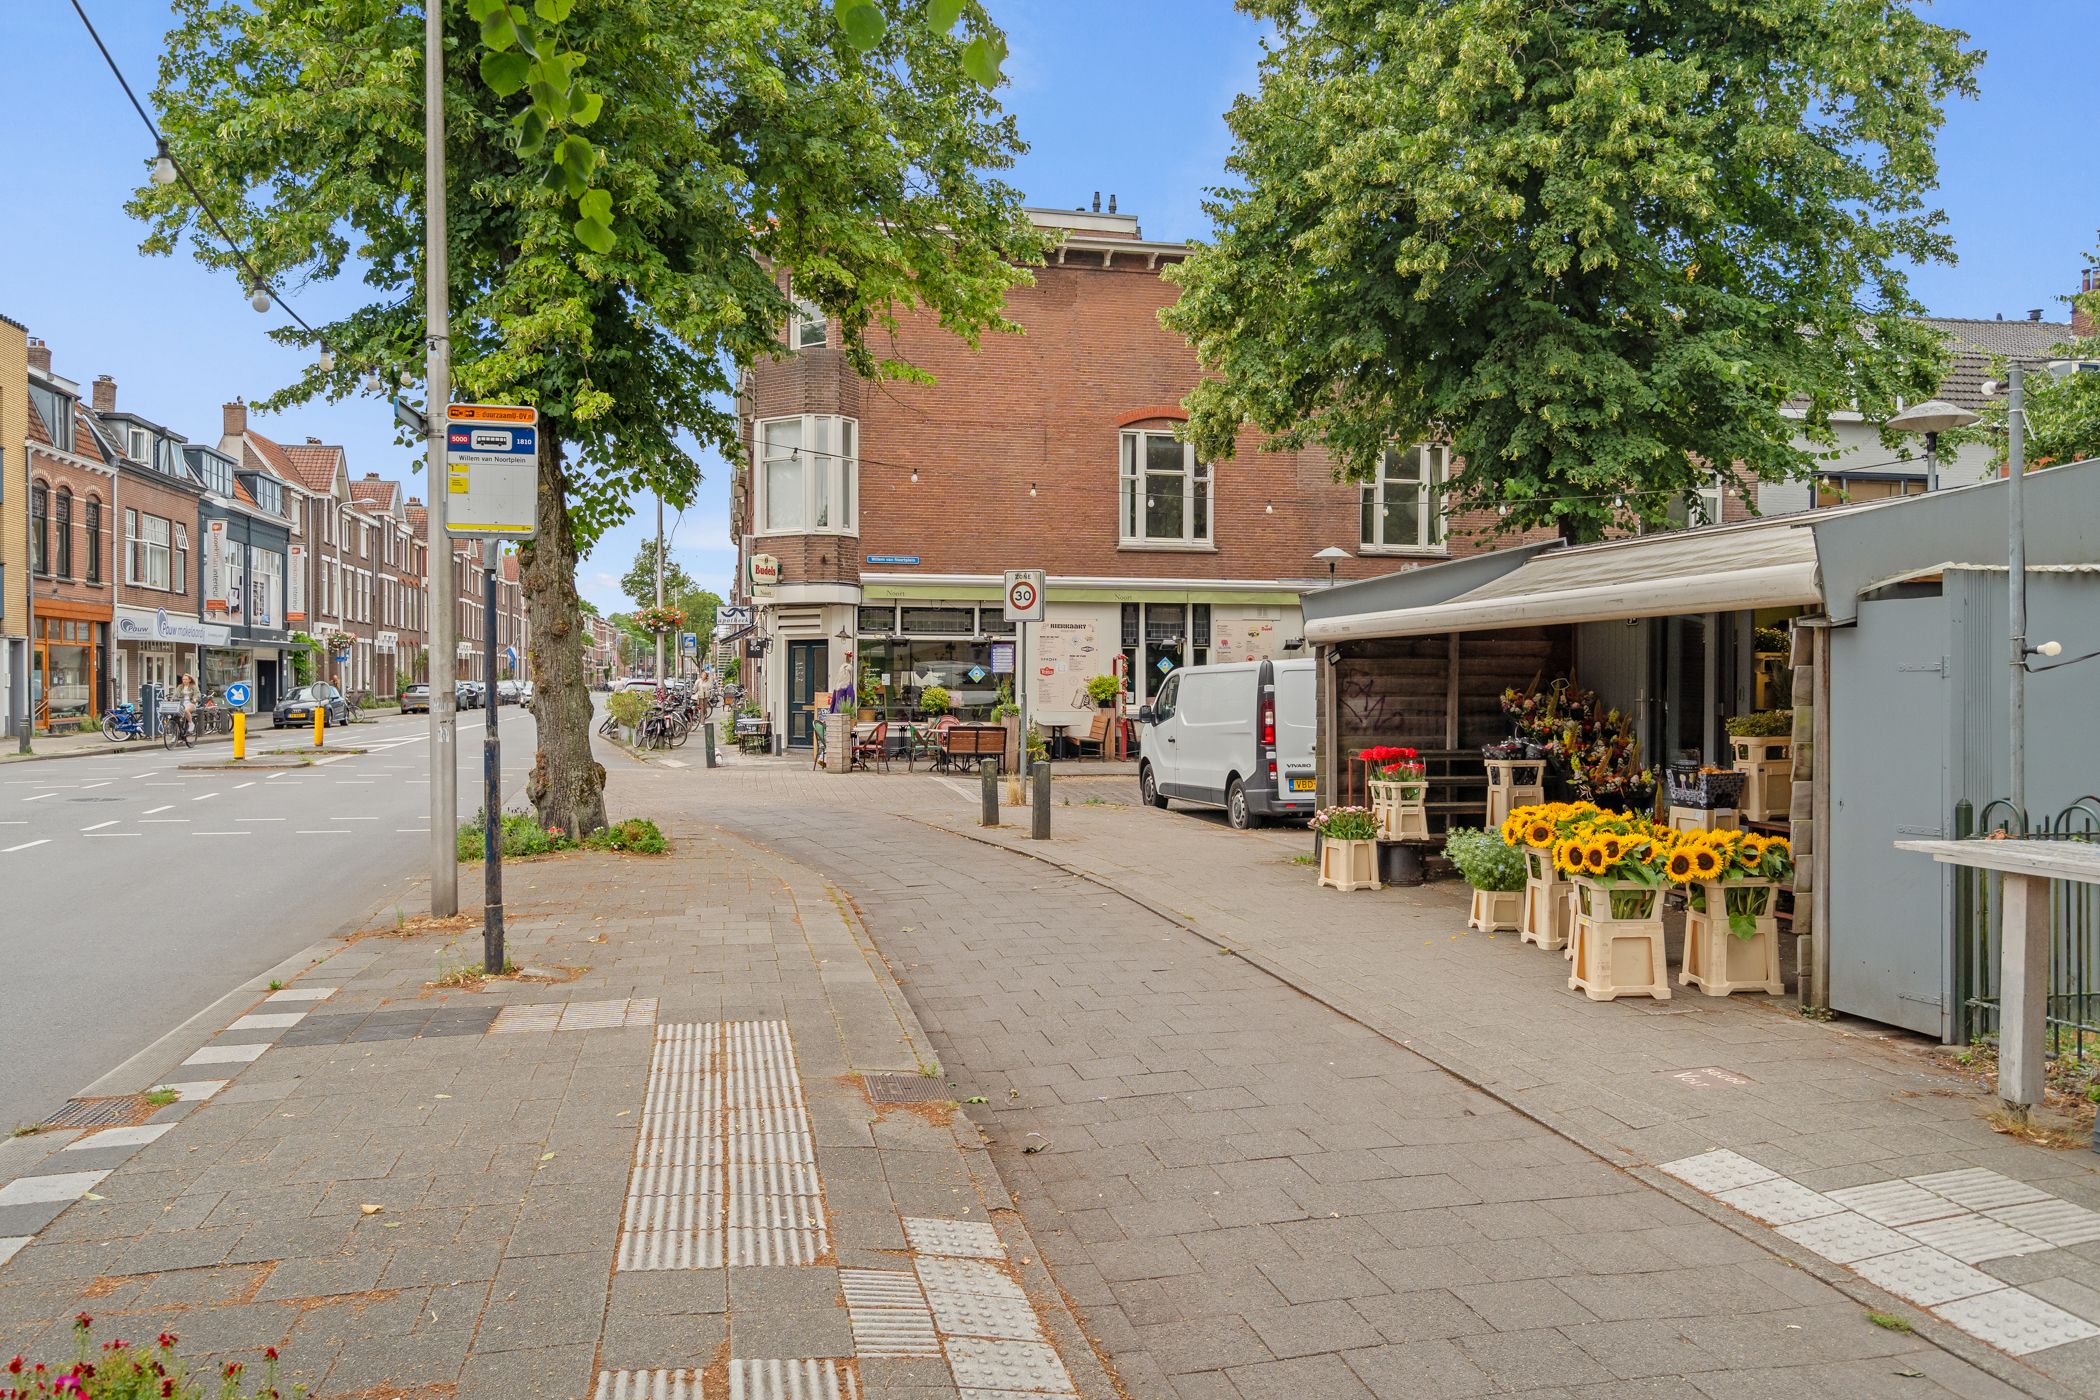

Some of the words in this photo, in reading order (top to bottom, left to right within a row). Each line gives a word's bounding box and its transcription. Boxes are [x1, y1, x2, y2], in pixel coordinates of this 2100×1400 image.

[755, 564, 776, 577] Budels
[1014, 590, 1032, 601] 30
[127, 625, 149, 633] Pouw
[161, 622, 177, 636] Pouw
